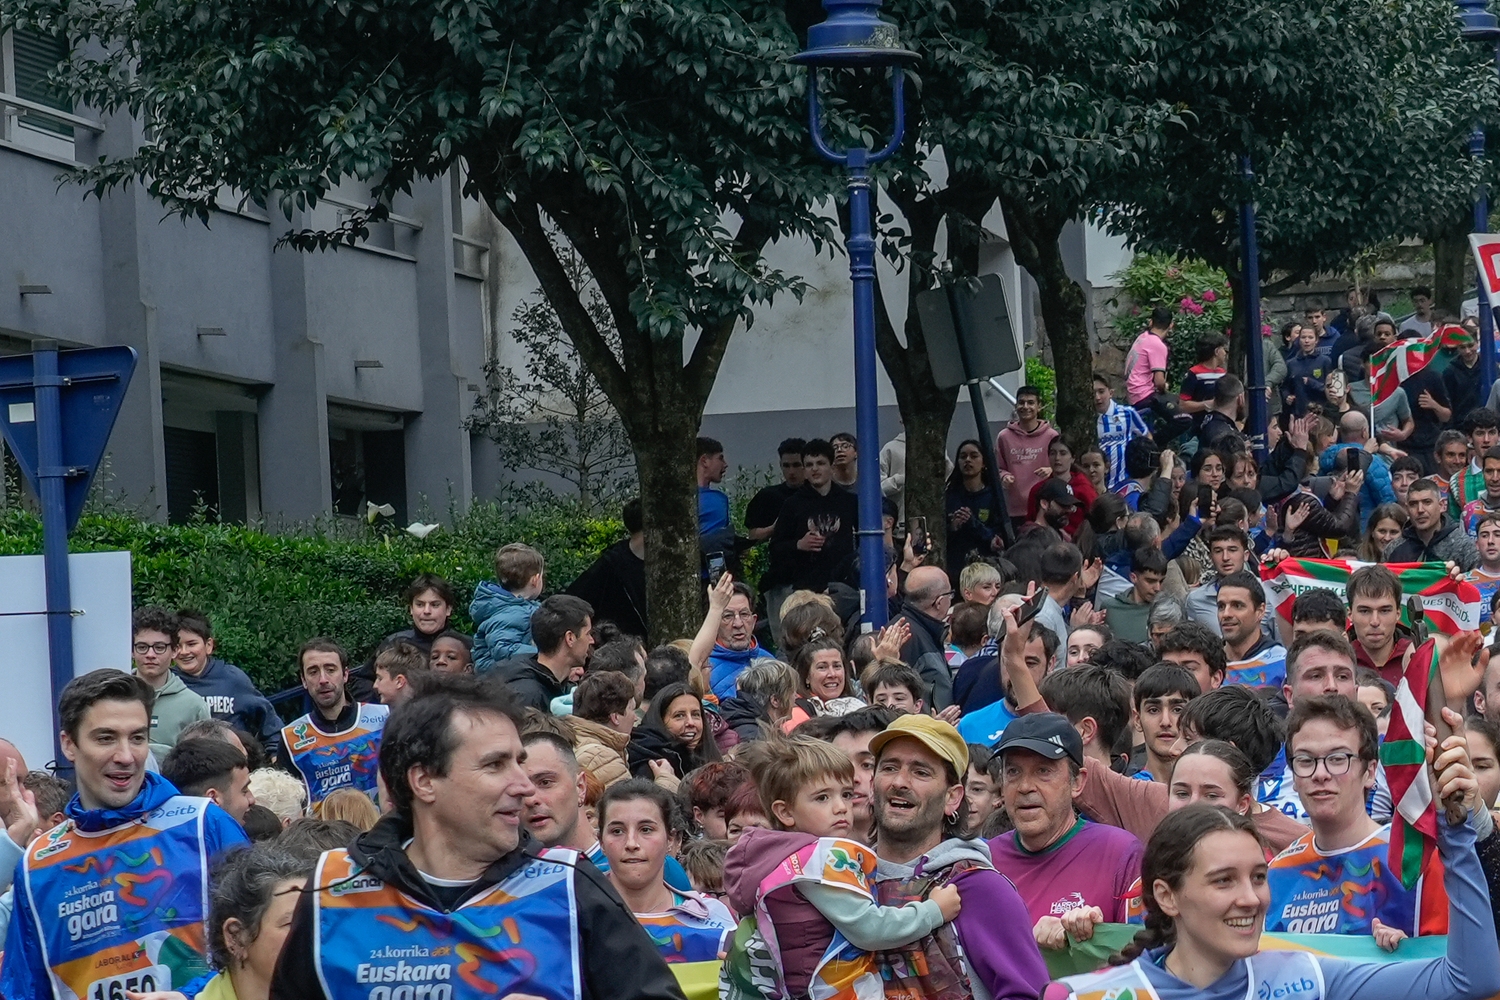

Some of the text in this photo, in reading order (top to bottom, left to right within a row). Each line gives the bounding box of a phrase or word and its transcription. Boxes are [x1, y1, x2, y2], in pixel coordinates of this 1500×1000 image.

[315, 765, 351, 780] Euskara
[321, 772, 352, 791] gara
[165, 805, 197, 818] eitb
[524, 861, 566, 880] eitb
[58, 890, 115, 918] Euskara
[1282, 899, 1340, 919] Euskara
[67, 904, 118, 941] gara
[95, 952, 132, 969] LABORAL
[370, 945, 429, 959] 24.korrika
[356, 960, 451, 984] Euskara
[1273, 978, 1315, 1000] eitb
